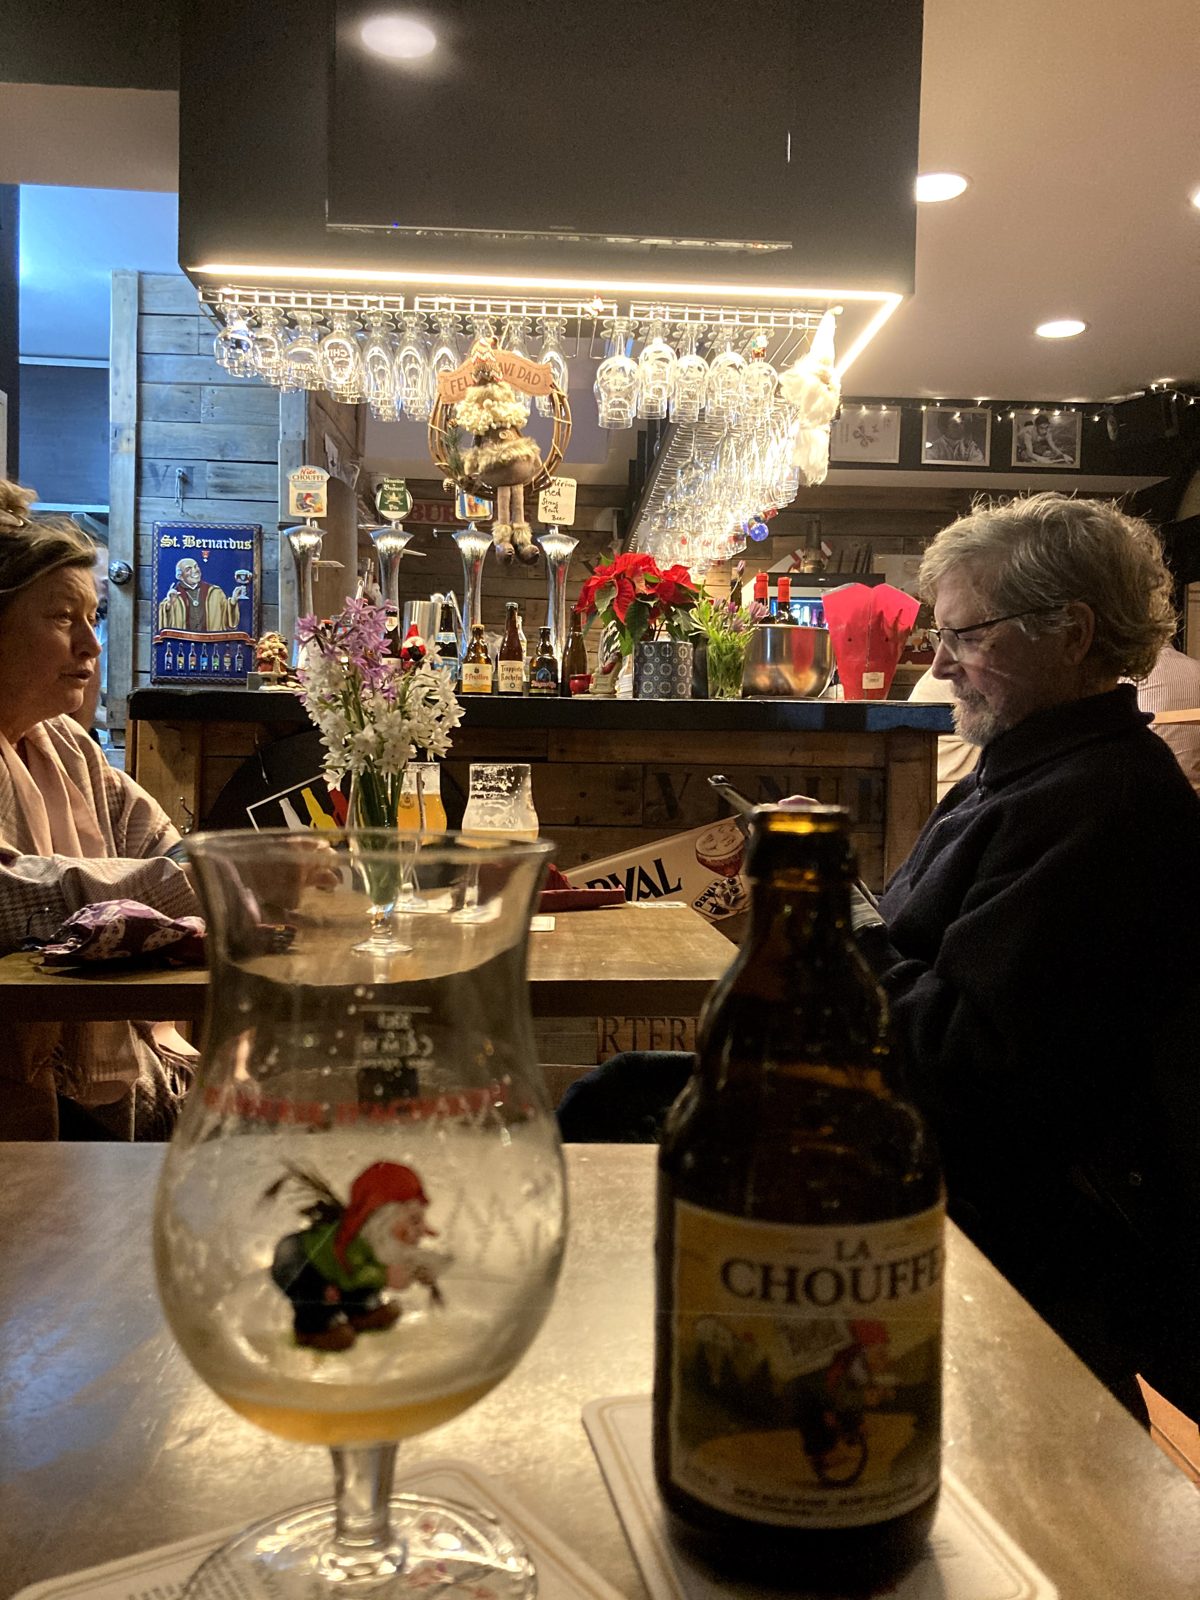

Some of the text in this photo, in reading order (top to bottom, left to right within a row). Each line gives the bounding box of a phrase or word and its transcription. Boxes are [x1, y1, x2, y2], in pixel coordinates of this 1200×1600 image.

[160, 534, 252, 551] St. Bernardus
[836, 1239, 871, 1263] LA
